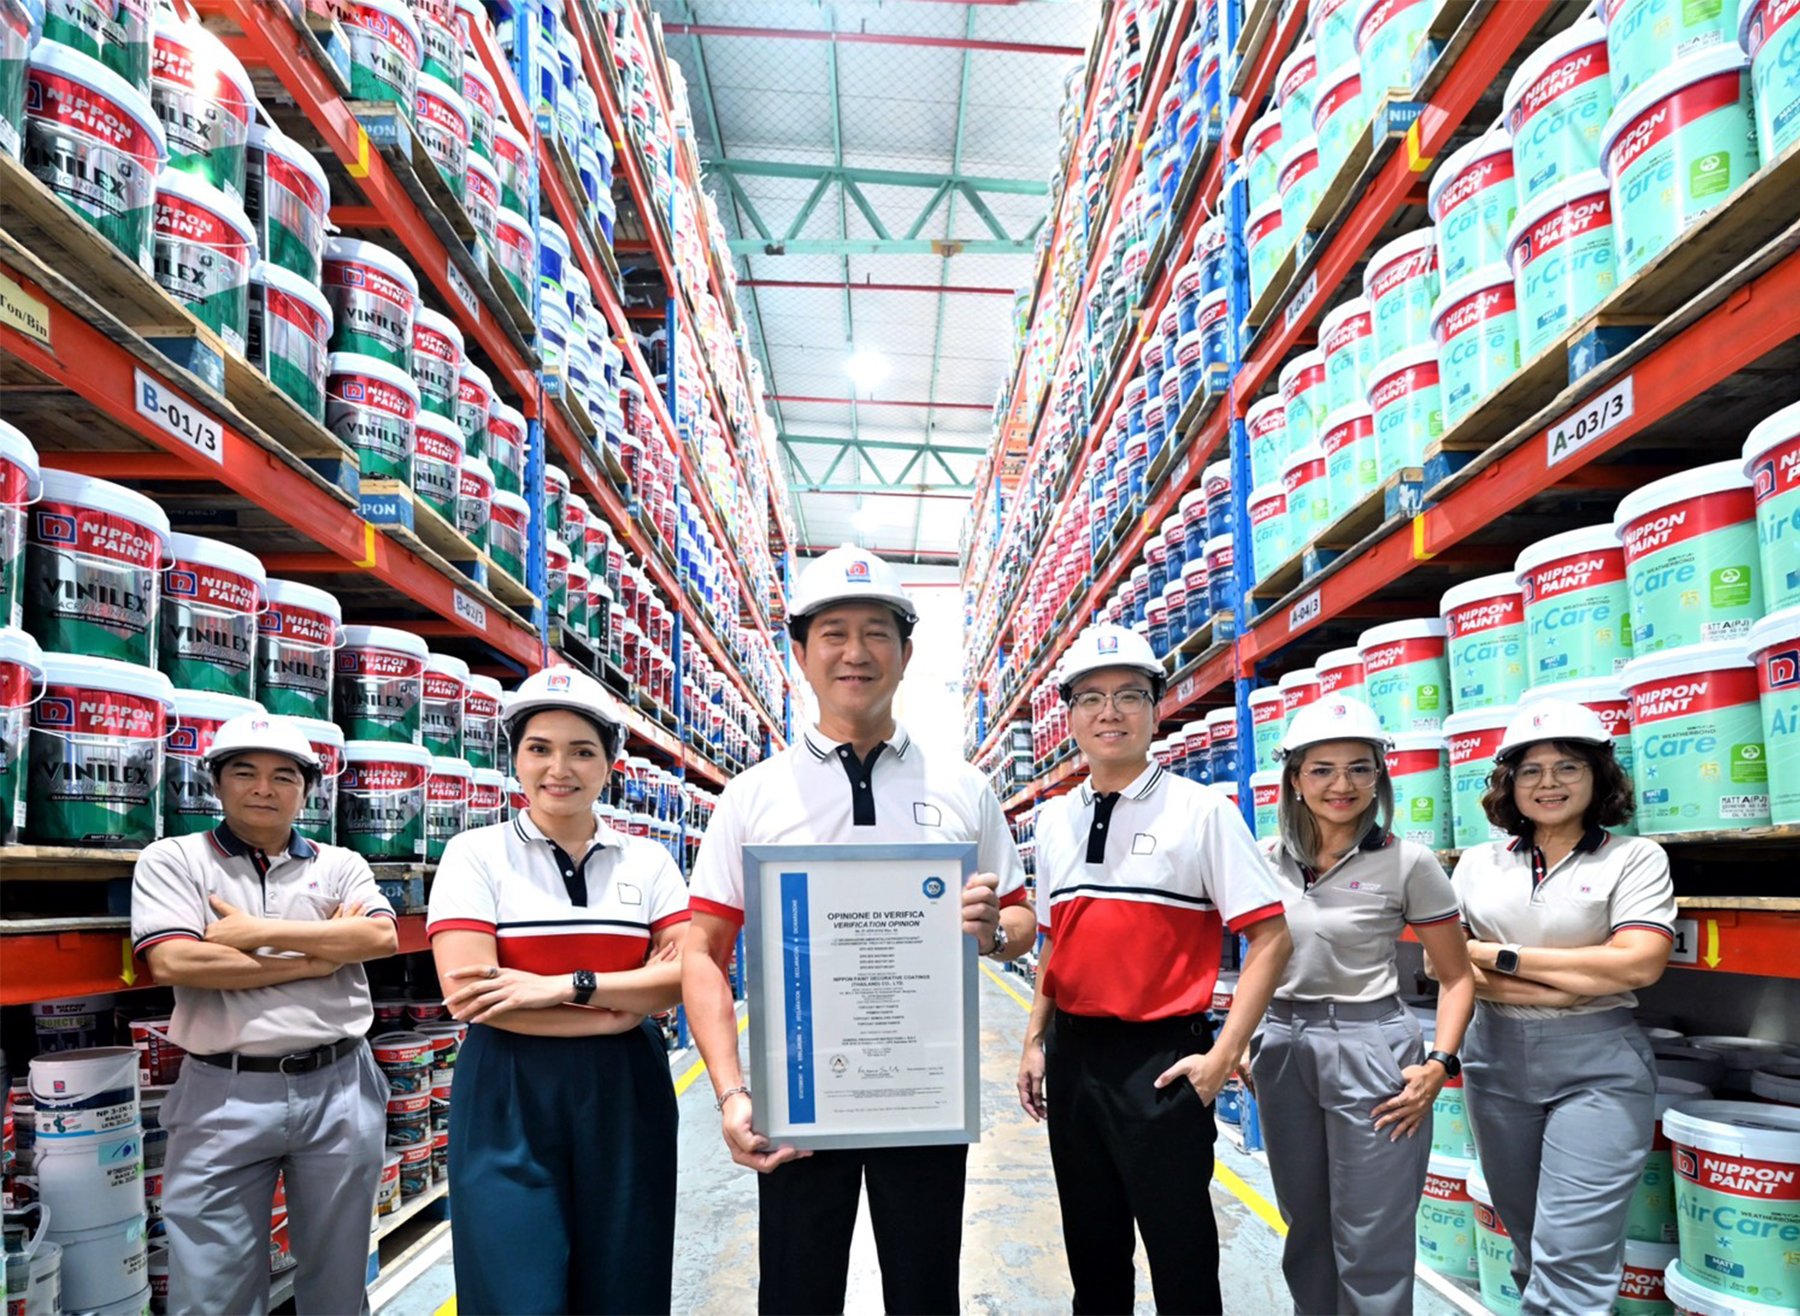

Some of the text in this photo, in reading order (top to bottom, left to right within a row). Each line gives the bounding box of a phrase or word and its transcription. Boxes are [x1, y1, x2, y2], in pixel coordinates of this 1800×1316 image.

[1524, 54, 1592, 104] NIPPON
[1529, 72, 1579, 112] PAINT
[47, 87, 132, 138] NIPPON
[57, 103, 122, 143] PAINT
[1389, 110, 1420, 121] NIP
[1535, 201, 1604, 239] NIPPON
[1539, 215, 1592, 249] PAINT
[1446, 292, 1500, 328] NIPPON
[1449, 306, 1489, 335] PAINT
[368, 387, 409, 410] NIPPON
[374, 394, 407, 415] PAINT
[143, 381, 216, 451] B-01/3
[1552, 394, 1624, 456] A-03/3
[347, 423, 406, 449] VINILEX
[82, 521, 153, 554] NIPPON
[1625, 511, 1686, 545] NIPPON
[92, 536, 149, 562] PAINT
[1628, 529, 1672, 557] PAINT
[1537, 558, 1605, 583] NIPPON
[201, 575, 254, 601] NIPPON
[1540, 573, 1592, 595] PAINT
[43, 578, 147, 616] VINILEX
[209, 588, 252, 609] PAINT
[456, 595, 485, 624] B-02/3
[286, 615, 332, 633] NIPPON
[1291, 599, 1320, 626] A-04/3
[1457, 602, 1514, 623] NIPPON
[1461, 614, 1503, 632] PAINT
[1530, 604, 1610, 636] irCare
[169, 625, 251, 653] VINILEX
[292, 624, 329, 641] PAINT
[360, 655, 408, 668] NIPPON
[1453, 641, 1520, 668] irCare
[260, 658, 328, 681] VINILEX
[366, 662, 404, 674] PAINT
[427, 686, 457, 697] PAINT
[1636, 682, 1708, 707] NIPPON
[79, 701, 155, 722] NIPPON
[1640, 698, 1692, 718] PAINT
[89, 714, 150, 733] PAINT
[1662, 729, 1716, 740] WEATHERBOND
[42, 761, 149, 787] VINILEX
[359, 769, 408, 780] NIPPON
[365, 776, 403, 786] PAINT
[431, 788, 460, 797] PAINT
[827, 911, 925, 921] OPINIONE DI VERIFICA
[833, 921, 886, 929] VERIFICATION
[1703, 1157, 1795, 1185] NIPPON
[1709, 1172, 1779, 1195] PAINT
